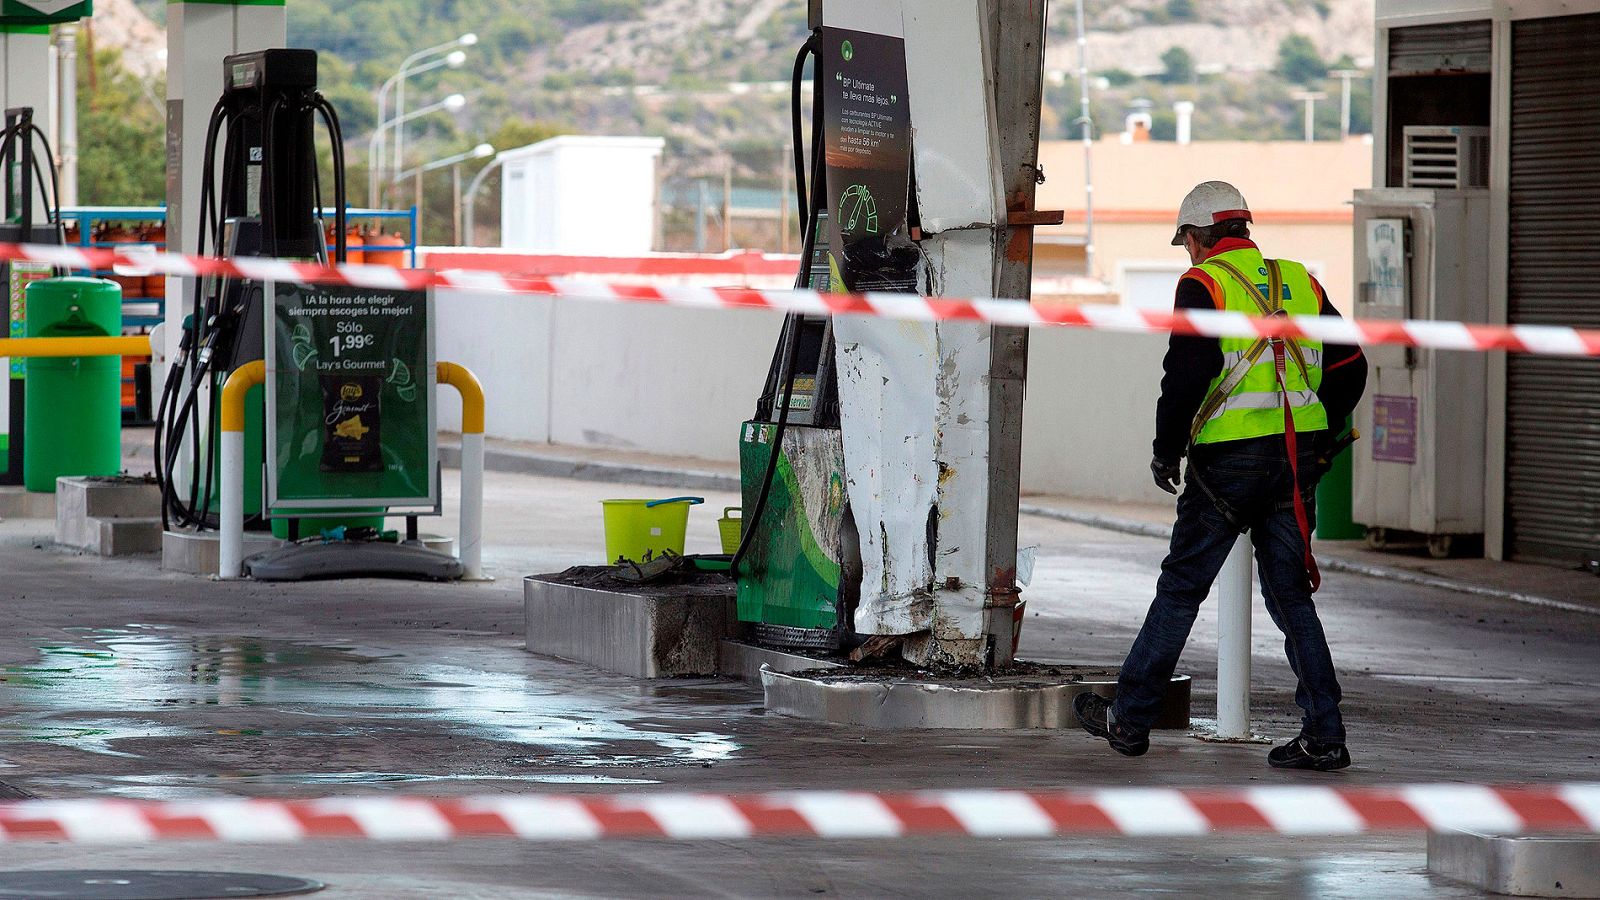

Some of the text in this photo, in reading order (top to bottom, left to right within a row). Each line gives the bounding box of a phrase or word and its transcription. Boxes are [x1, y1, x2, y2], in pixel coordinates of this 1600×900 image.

[853, 79, 875, 91] Ultimate
[842, 91, 849, 100] te
[850, 91, 862, 101] lleva
[863, 94, 875, 103] más
[847, 135, 861, 145] hasta
[319, 295, 328, 305] la
[329, 295, 352, 305] hora
[353, 295, 366, 305] de
[368, 295, 395, 306] elegir
[288, 306, 413, 318] siempre escoges lo mejor!
[336, 321, 363, 333] Sólo
[329, 334, 374, 357] 1,99€
[316, 360, 385, 371] Lay's Gourmet
